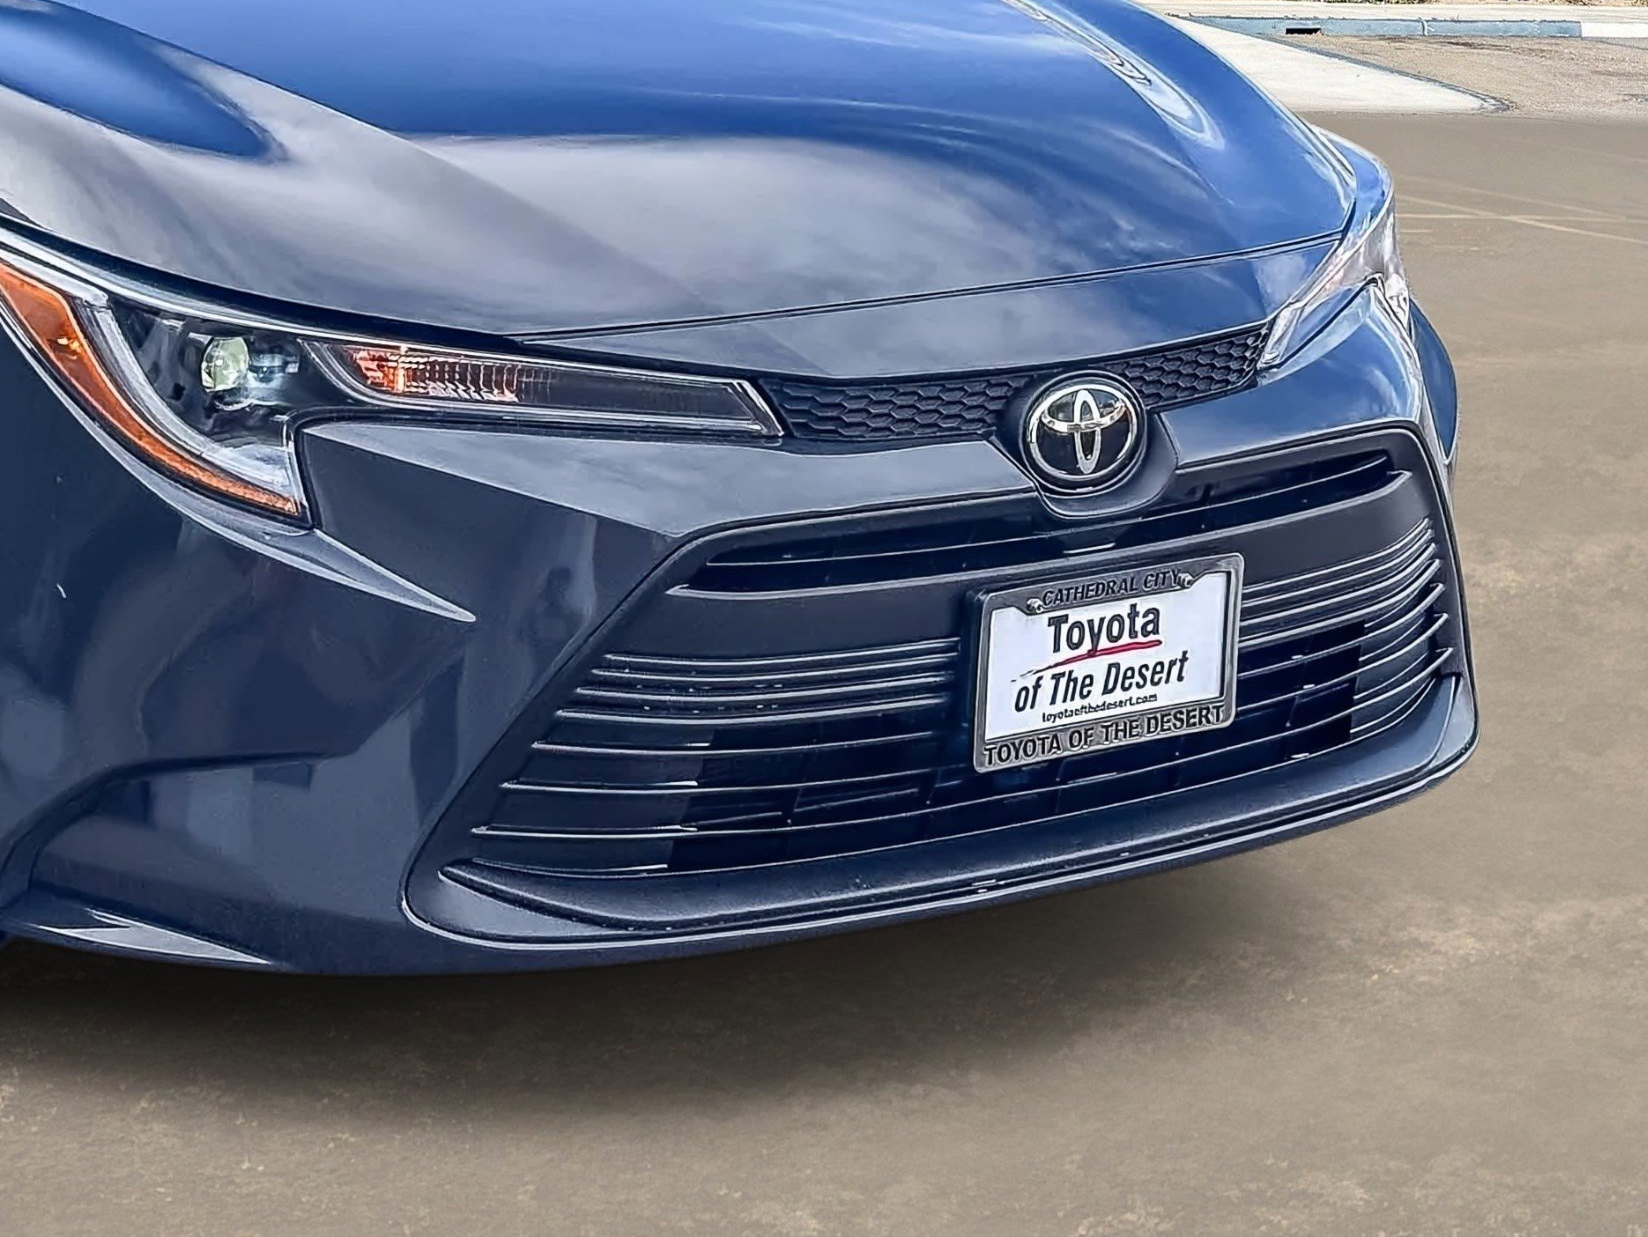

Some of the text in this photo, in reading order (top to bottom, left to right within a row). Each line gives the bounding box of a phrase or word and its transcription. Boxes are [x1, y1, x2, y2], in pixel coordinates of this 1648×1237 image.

[1042, 569, 1181, 607] CATHEDRAL CITY
[1048, 603, 1161, 656] Toyota
[1014, 650, 1189, 712] of The Desert
[984, 704, 1225, 765] TOYOTA OF THE DESERT
